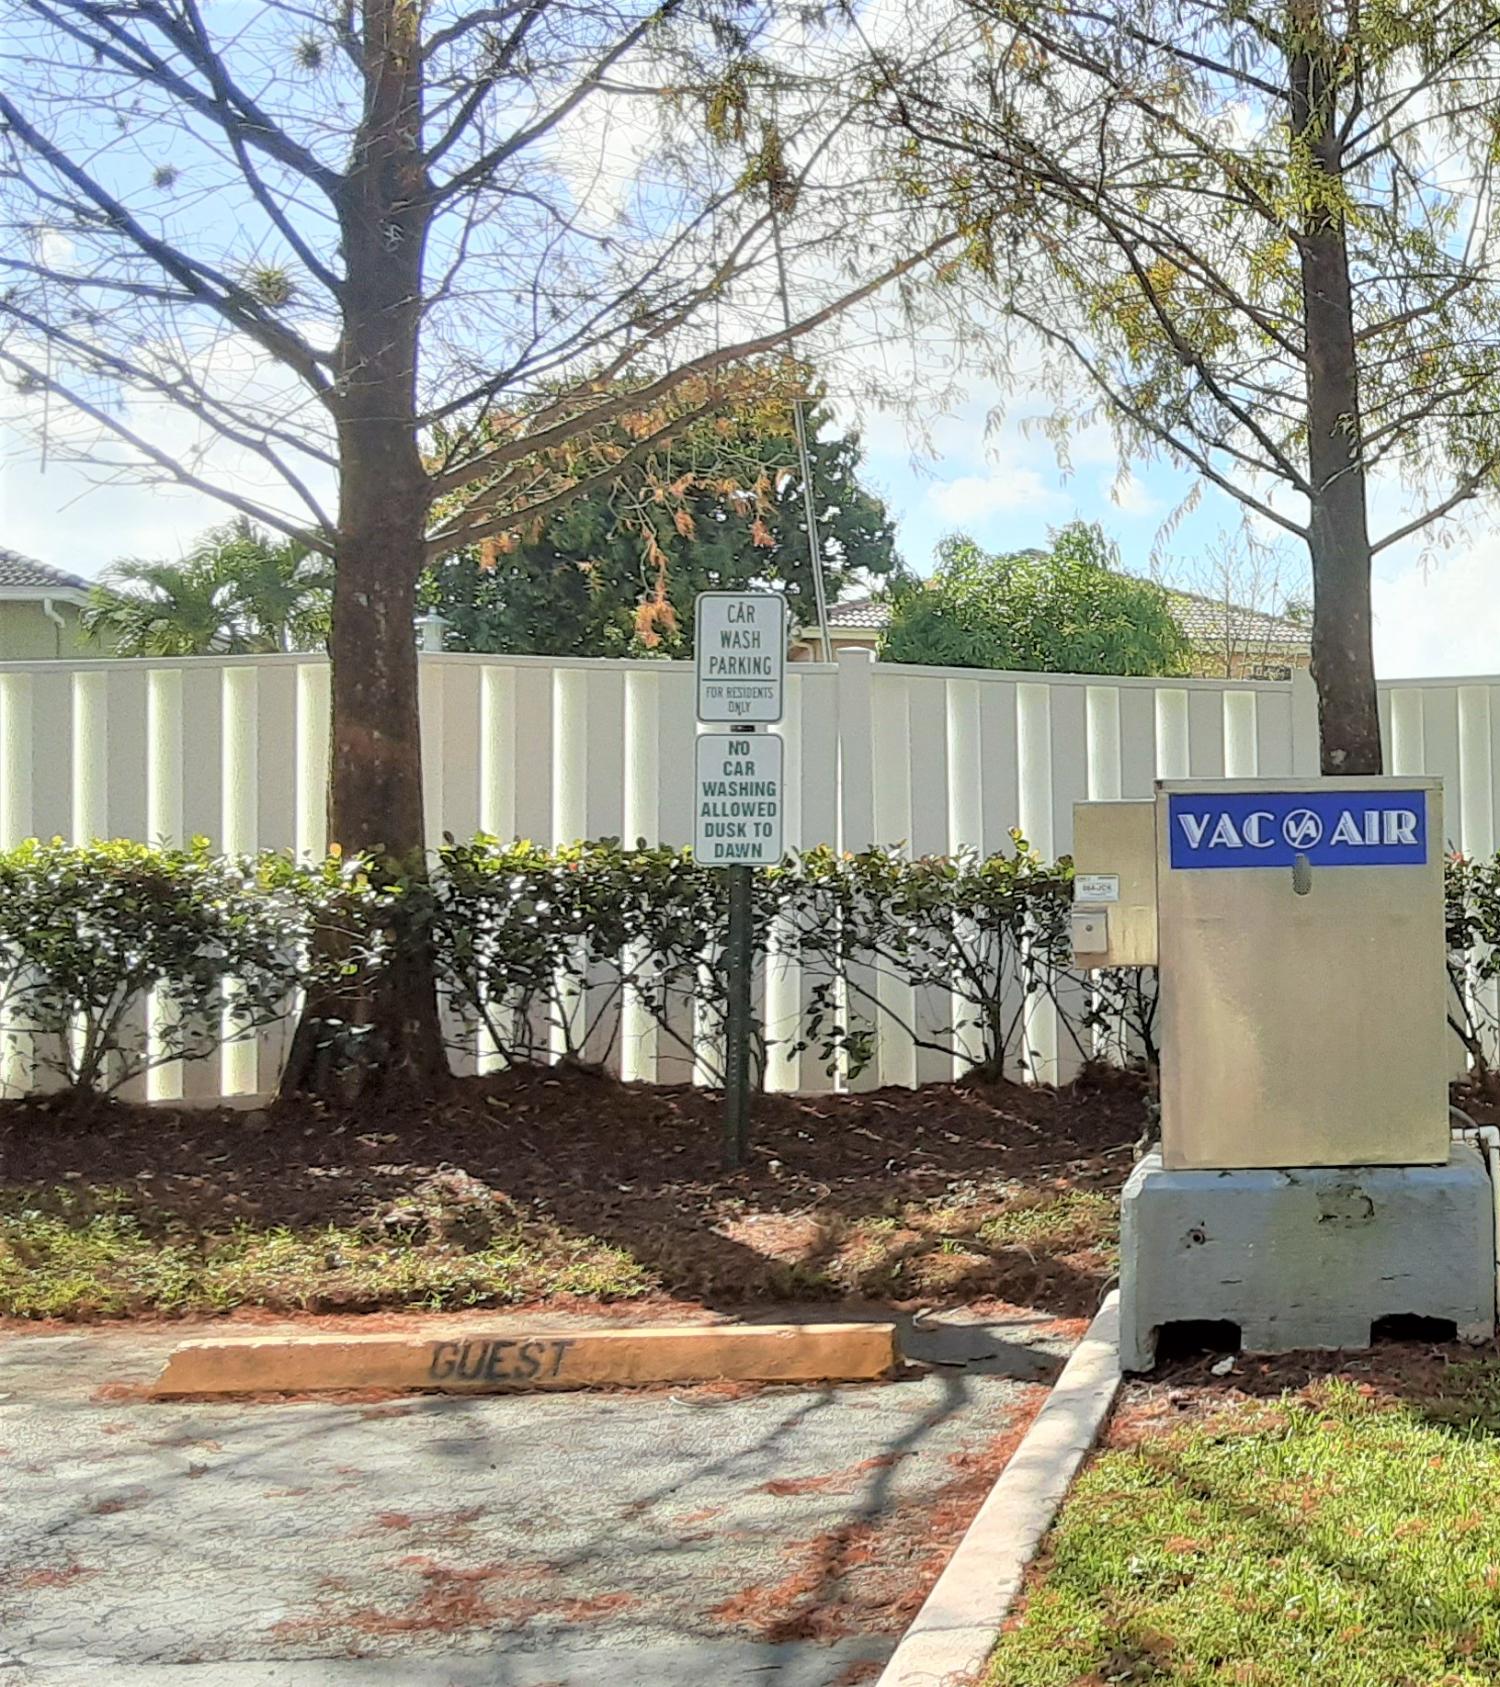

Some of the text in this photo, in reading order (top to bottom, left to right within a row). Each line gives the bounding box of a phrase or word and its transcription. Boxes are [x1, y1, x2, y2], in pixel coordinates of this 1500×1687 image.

[727, 603, 755, 624] CAR
[720, 630, 761, 649] WASH
[709, 656, 772, 675] PARKING
[706, 687, 774, 699] FOR RESIDENTS
[728, 701, 751, 713] ONLY
[728, 740, 750, 756] NO
[722, 761, 755, 776] CAR
[702, 781, 777, 797] WASHING
[700, 801, 777, 818] ALLOWED
[704, 822, 773, 838] DUSK TO
[1177, 811, 1275, 849] VAC
[1330, 810, 1418, 846] AIR
[714, 843, 763, 859] DAWN
[430, 1340, 575, 1380] GUEST
